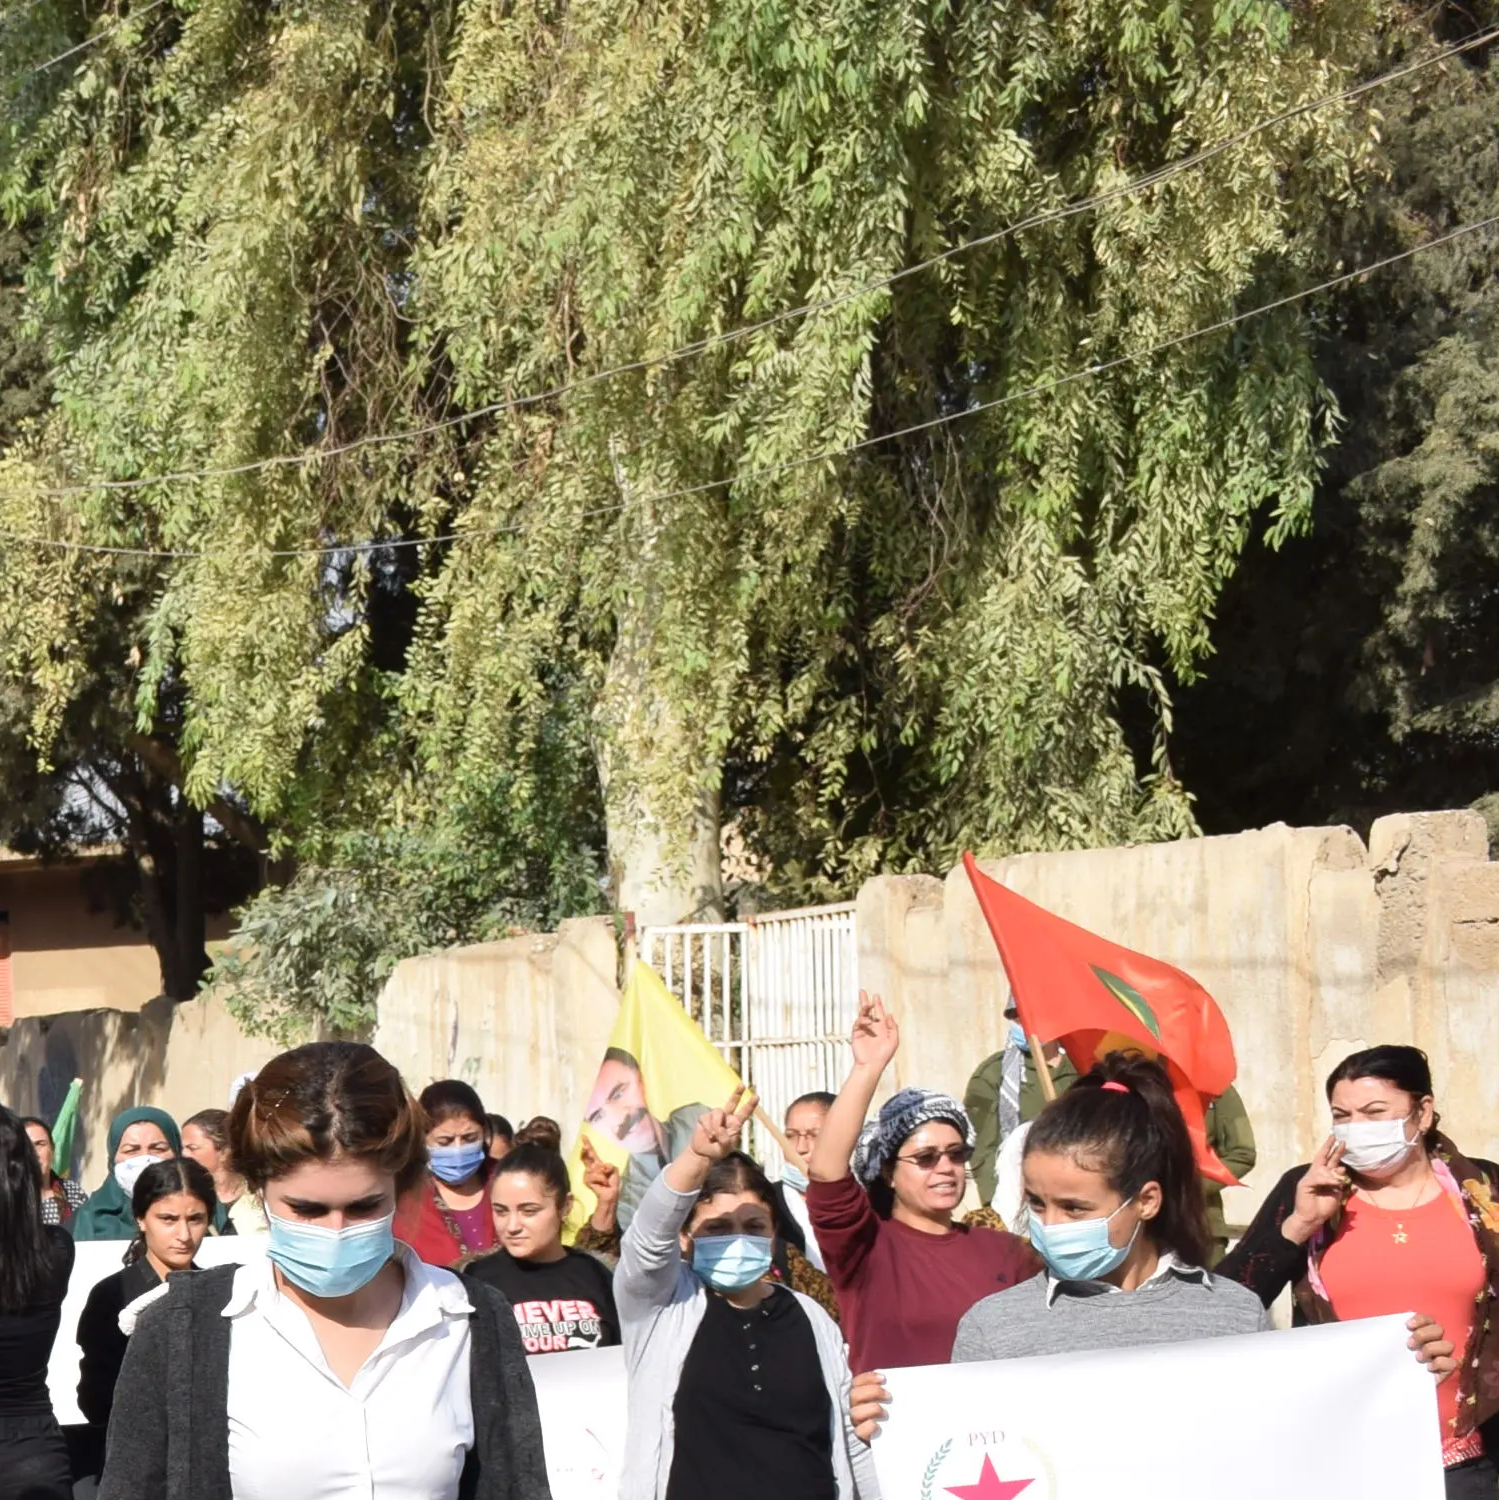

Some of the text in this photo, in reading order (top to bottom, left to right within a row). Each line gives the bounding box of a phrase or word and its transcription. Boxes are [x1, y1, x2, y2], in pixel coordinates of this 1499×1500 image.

[518, 1322, 551, 1338] IVE
[552, 1320, 577, 1336] UP
[522, 1334, 569, 1353] OUR
[967, 1429, 1006, 1447] PYD
